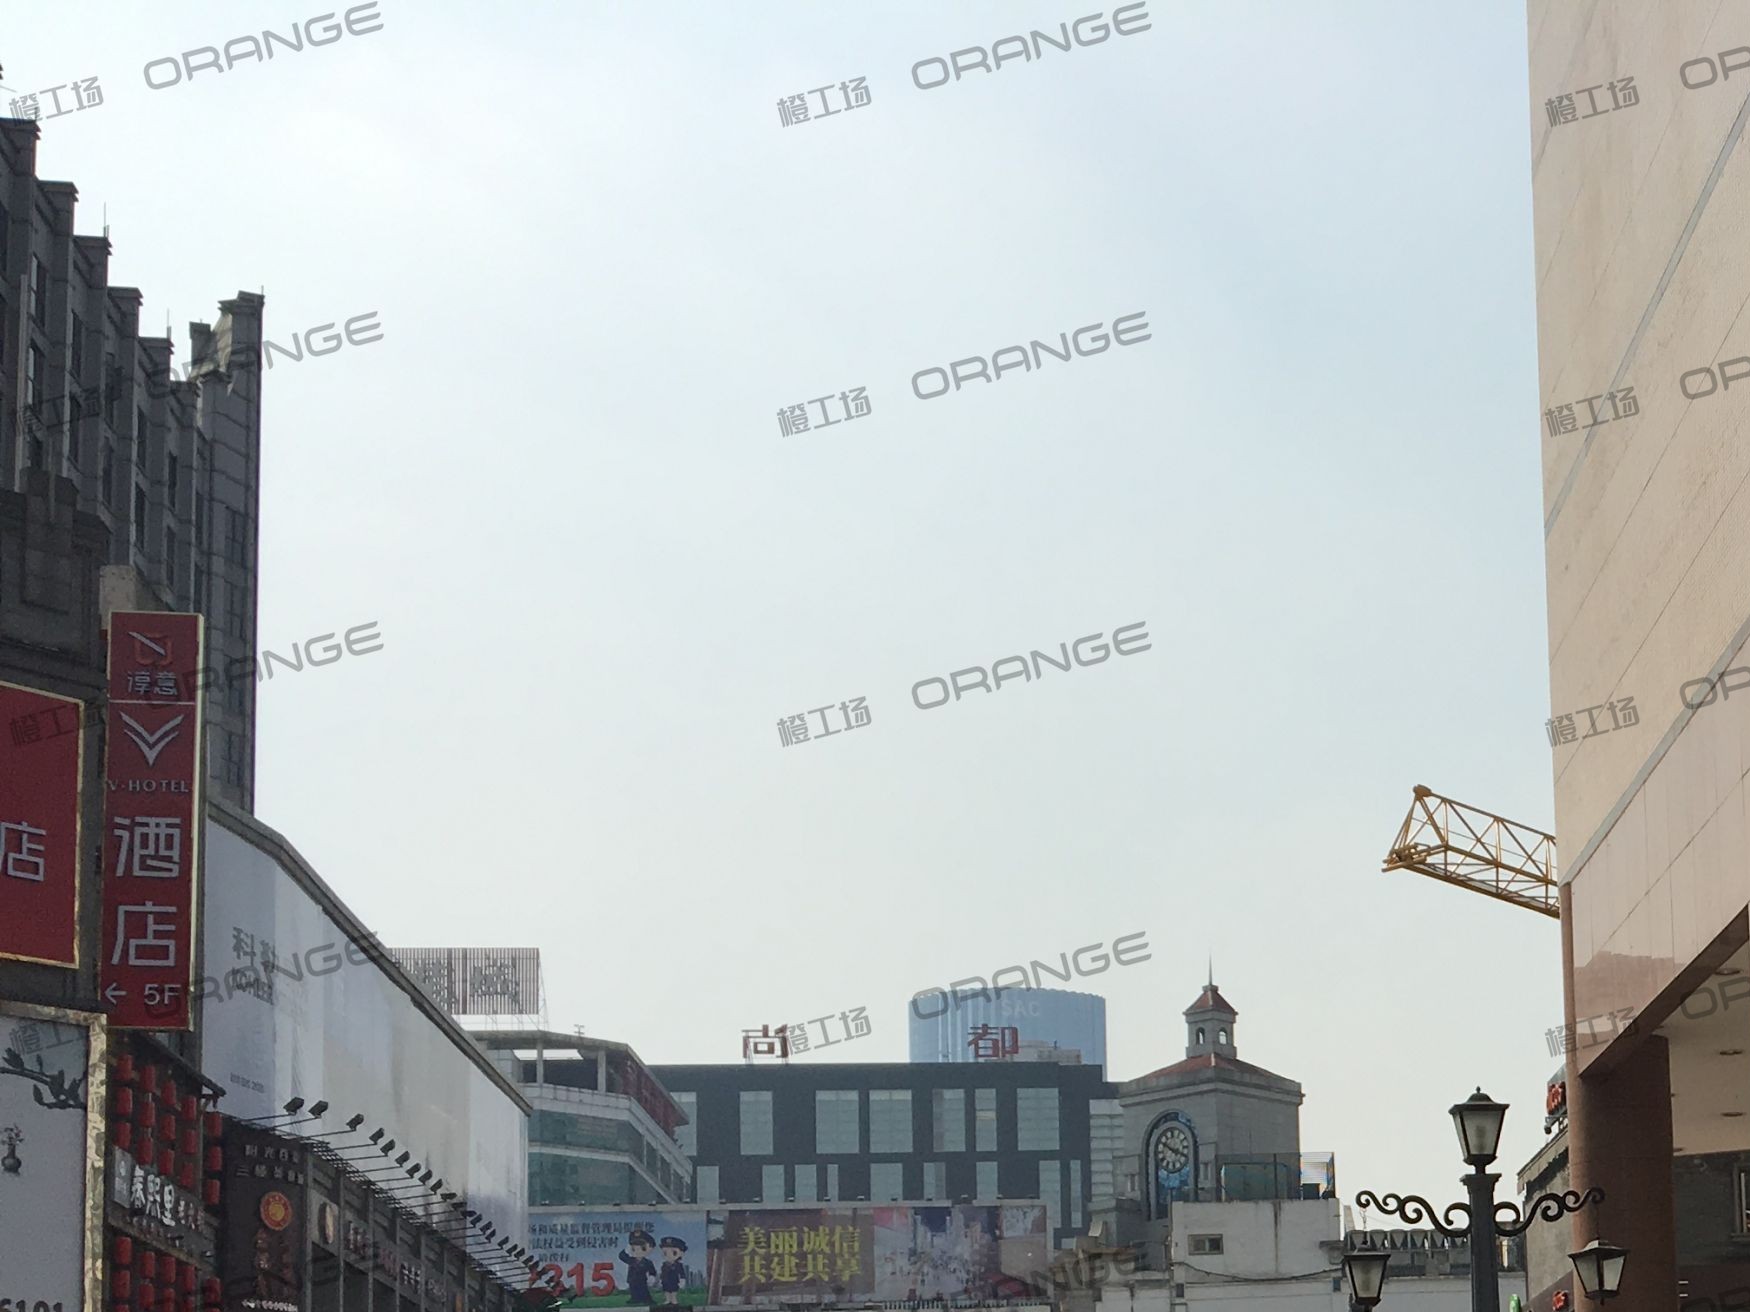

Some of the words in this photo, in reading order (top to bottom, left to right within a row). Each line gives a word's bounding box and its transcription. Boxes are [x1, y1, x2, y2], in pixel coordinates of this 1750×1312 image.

[1, 822, 45, 882] 店
[112, 815, 181, 968] 酒店
[144, 985, 182, 1006] 5F
[737, 1225, 861, 1254] 美丽诚信
[738, 1254, 862, 1283] 共建共享
